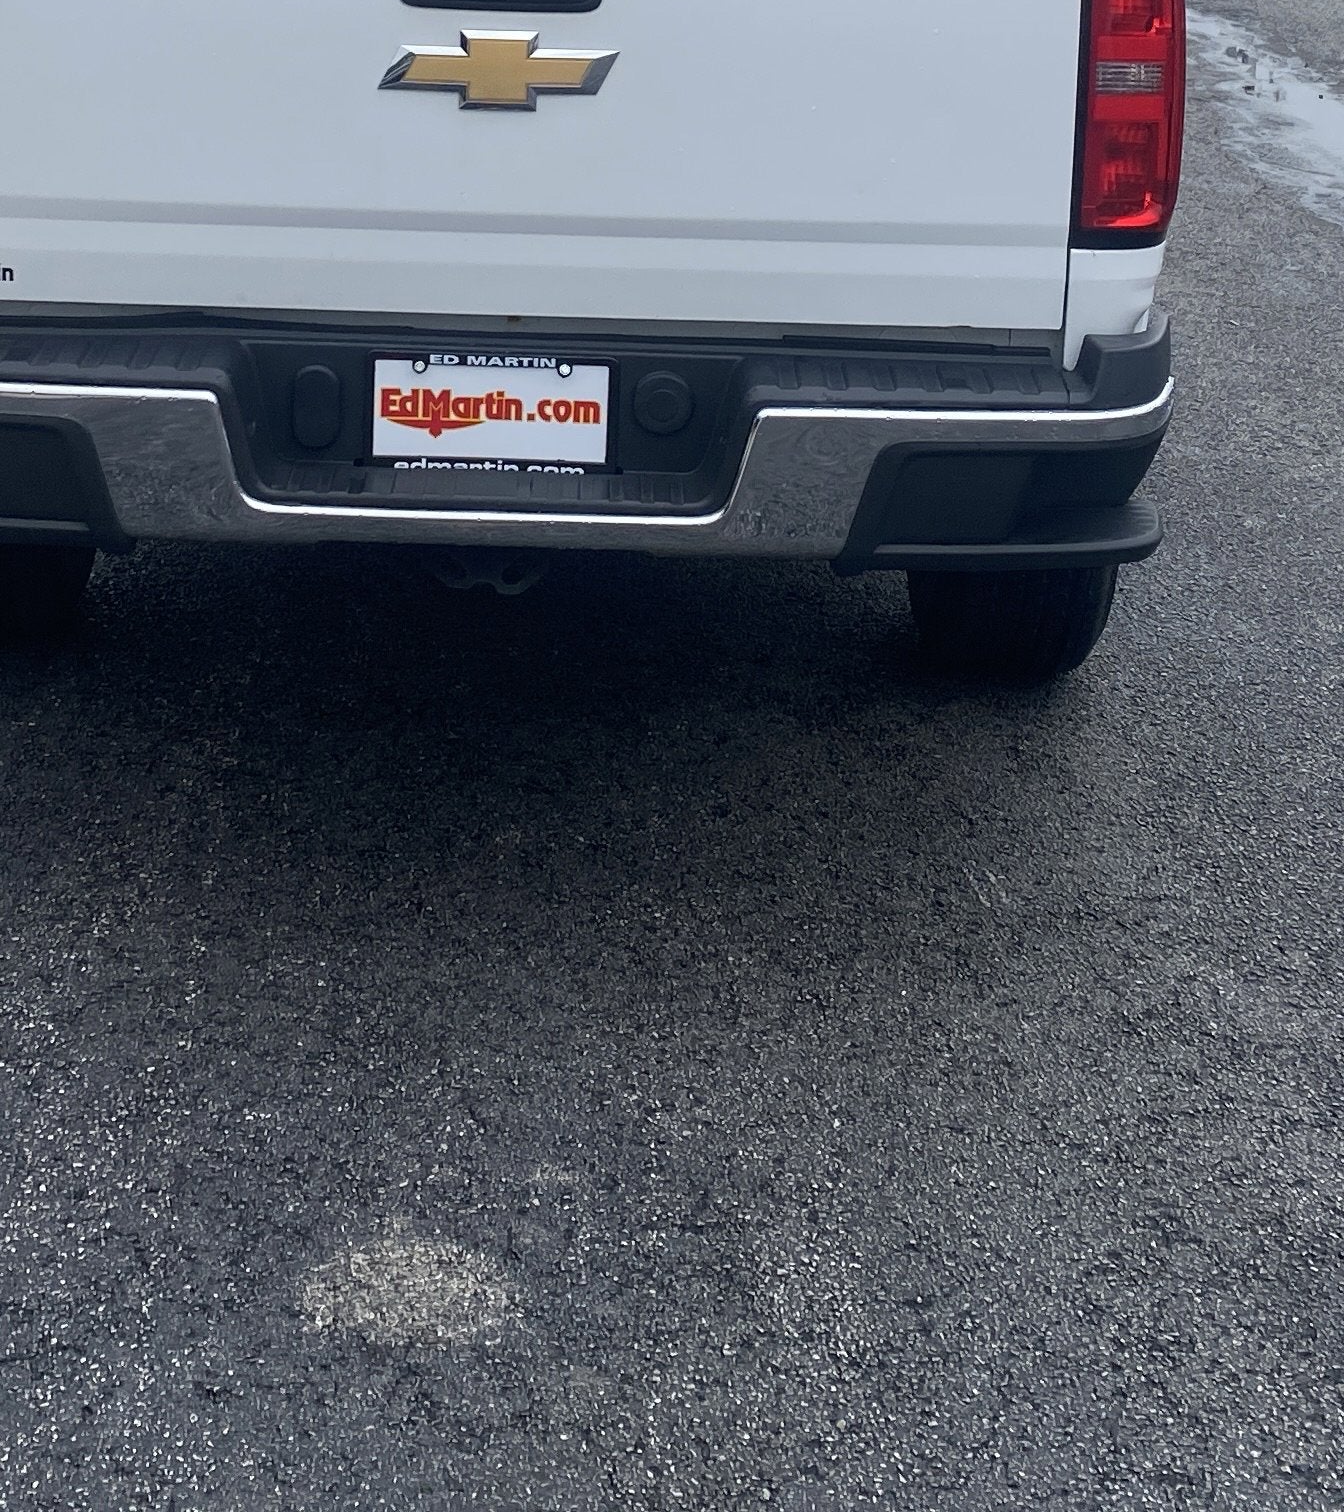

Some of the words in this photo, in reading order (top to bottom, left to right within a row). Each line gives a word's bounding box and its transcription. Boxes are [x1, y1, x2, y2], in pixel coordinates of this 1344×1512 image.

[429, 354, 460, 365] ED
[467, 355, 557, 368] MARTIN
[381, 388, 601, 432] EdMartin.com
